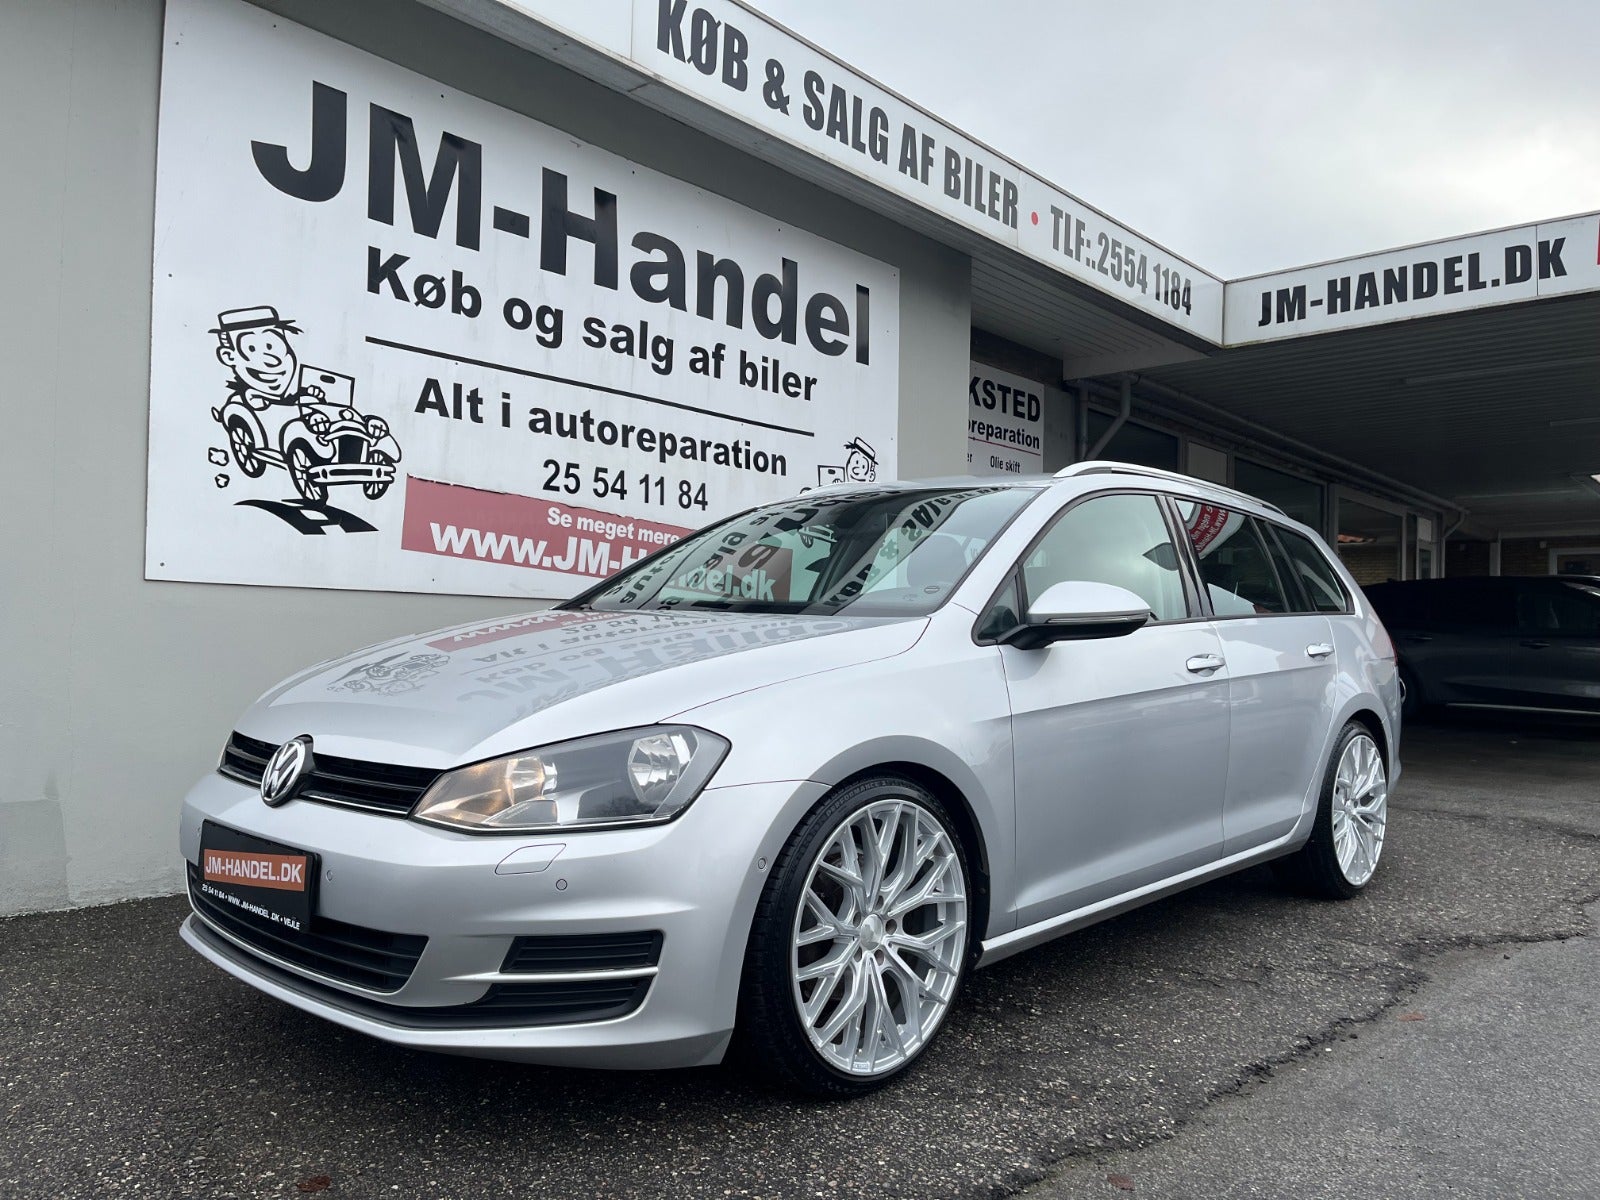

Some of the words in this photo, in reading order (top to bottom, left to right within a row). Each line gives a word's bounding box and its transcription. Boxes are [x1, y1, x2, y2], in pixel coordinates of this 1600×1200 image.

[657, 0, 749, 92] KØB
[763, 58, 790, 117] &
[803, 70, 889, 166] SALG
[899, 122, 935, 186] AF
[944, 145, 1018, 230] BILER
[1153, 263, 1192, 317] 1184
[251, 80, 870, 366] JM-Handel
[1258, 236, 1567, 327] JM-HANDEL.DK
[367, 246, 482, 319] Køb
[503, 297, 564, 349] og
[583, 316, 674, 372] salg
[689, 342, 727, 380] af
[740, 349, 818, 402] biler
[415, 377, 484, 424] Alt
[502, 391, 511, 429] i
[529, 407, 787, 477] autoreparation
[543, 458, 581, 495] 25
[593, 466, 628, 501] 54
[640, 473, 665, 506] 11
[679, 479, 709, 512] 84
[990, 455, 1004, 470] Olie
[1005, 459, 1021, 474] skift
[548, 506, 573, 528] Se
[577, 516, 635, 540] meget
[638, 528, 681, 547] mere
[205, 856, 303, 884] JM-HANDEL.DK
[284, 916, 301, 931] VEJLE
